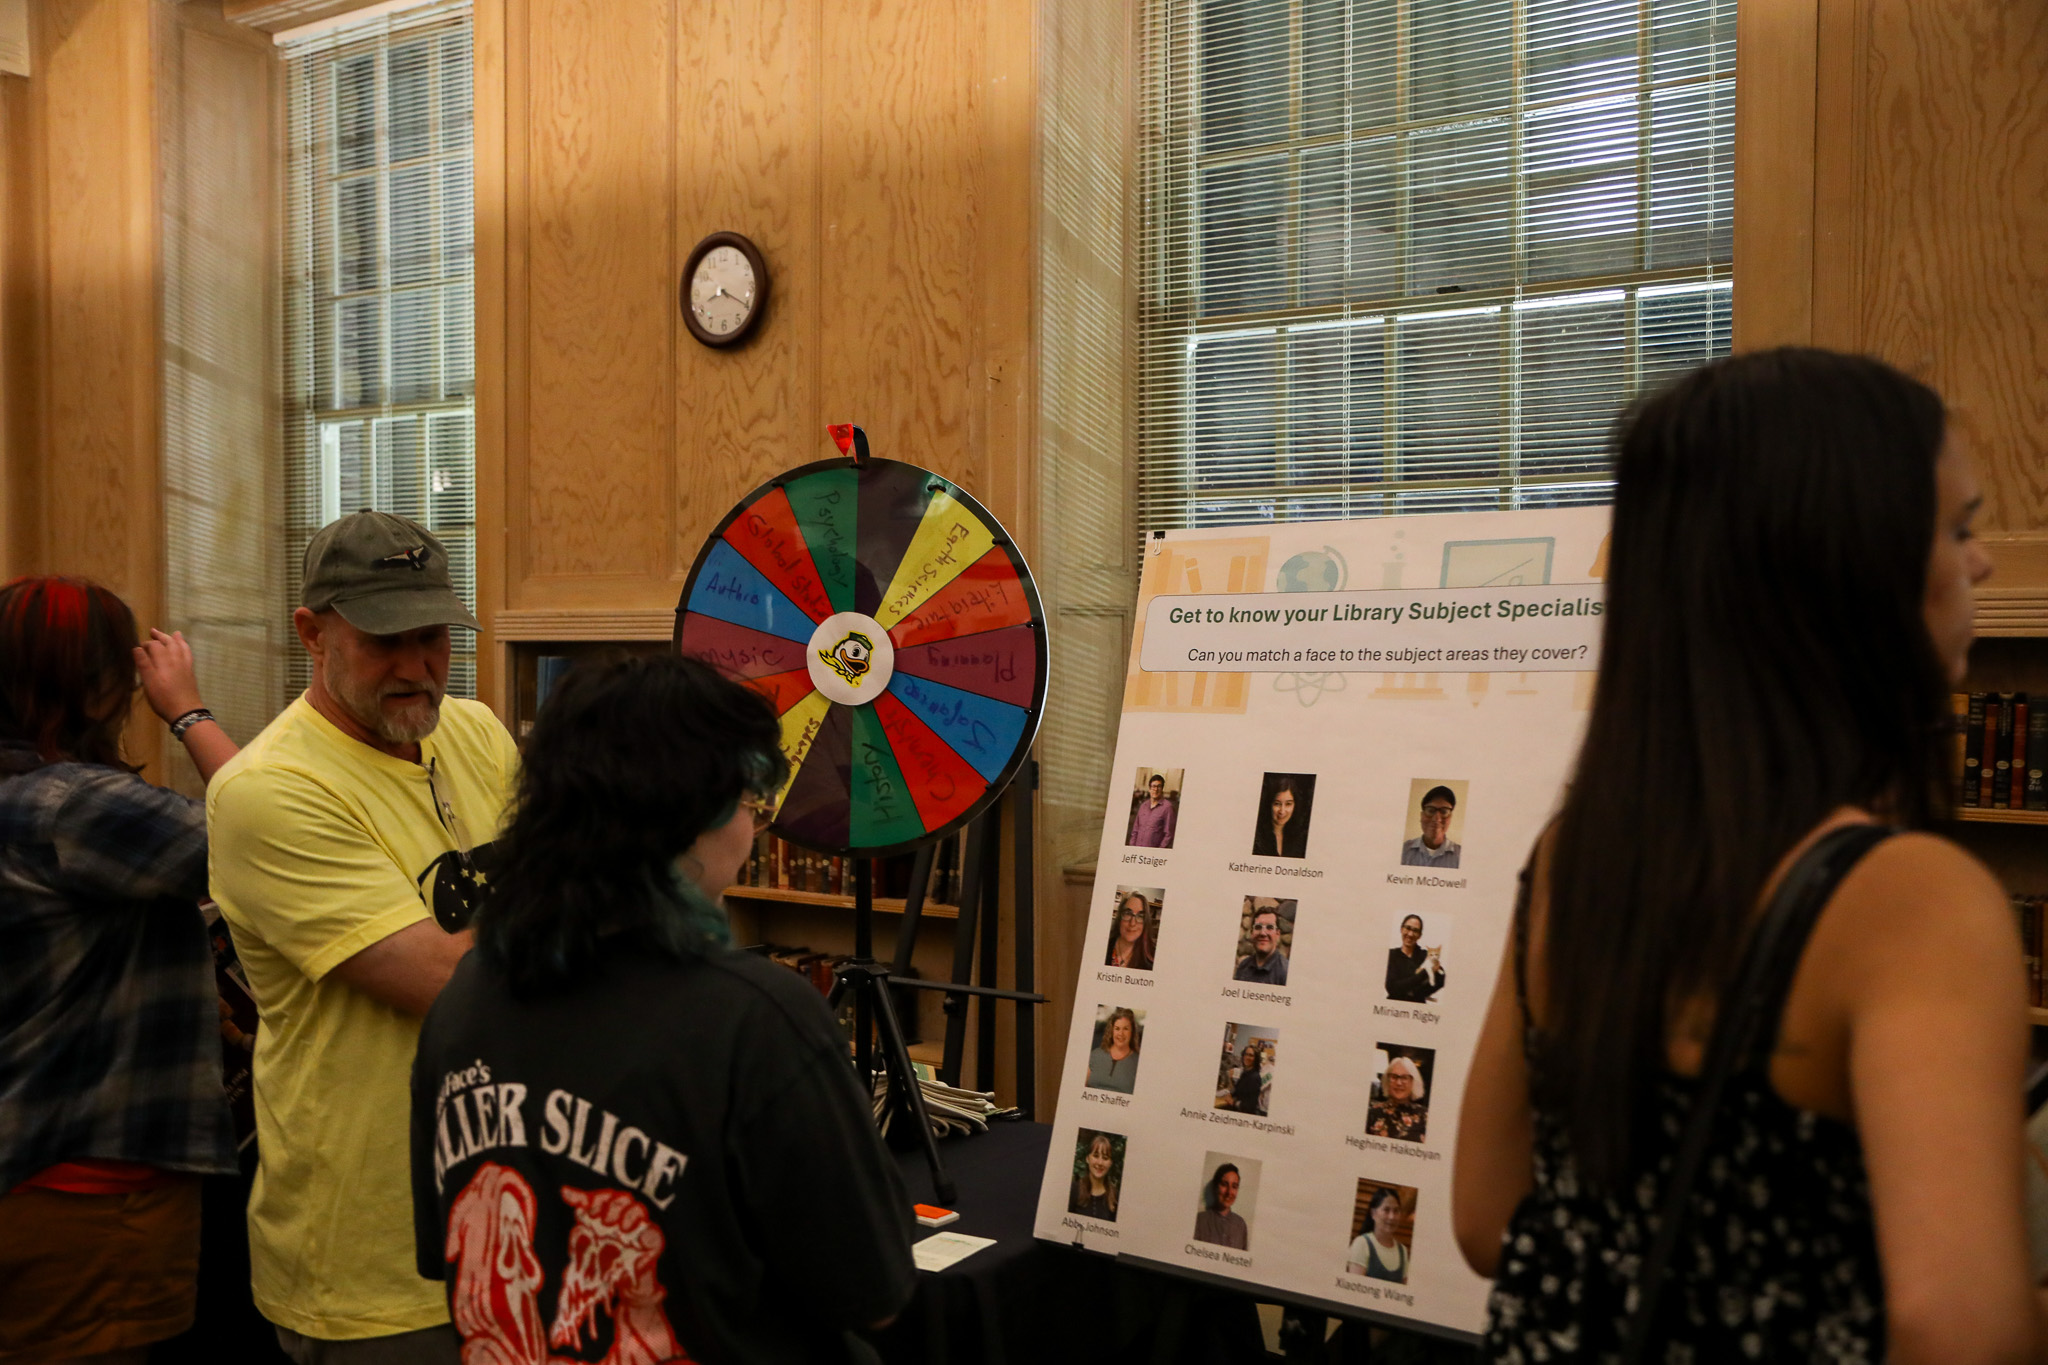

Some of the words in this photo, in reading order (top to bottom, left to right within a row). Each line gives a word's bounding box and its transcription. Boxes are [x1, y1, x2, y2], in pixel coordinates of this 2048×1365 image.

[747, 514, 801, 573] Global
[1169, 608, 1201, 624] Get
[1205, 608, 1224, 624] to
[1228, 606, 1280, 624] know
[1284, 607, 1328, 626] your
[1333, 603, 1403, 625] Library
[1408, 601, 1491, 622] Subject
[1497, 599, 1604, 621] Specialis
[926, 644, 1016, 683] Planning
[1187, 649, 1215, 662] Can
[1218, 651, 1243, 665] you
[1246, 648, 1291, 662] match
[1294, 652, 1302, 661] a
[1305, 648, 1336, 661] face
[1340, 650, 1354, 661] to
[1357, 648, 1382, 661] the
[1385, 647, 1442, 664] subject
[1446, 649, 1489, 661] areas
[1493, 646, 1528, 663] they
[1531, 645, 1588, 660] cover?
[861, 742, 904, 826] History
[1121, 854, 1137, 865] Jeff
[1138, 855, 1168, 868] Staiger
[1228, 862, 1272, 875] Katherine
[1274, 865, 1324, 878] Donaldson
[1386, 874, 1414, 885] Kevin
[1415, 876, 1467, 889] McDowell
[1096, 972, 1122, 984] Kristin
[1124, 975, 1154, 987] Buxton
[1221, 987, 1240, 999] Joel
[1242, 989, 1292, 1006] Liesenberg
[1372, 1005, 1410, 1020] Miriam
[1412, 1009, 1440, 1024] Rigby
[1081, 1091, 1099, 1102] Ann
[1100, 1093, 1131, 1107] Shaffer
[1180, 1107, 1207, 1122] Annie
[1208, 1111, 1295, 1136] Zeidman-Karpinski
[540, 1089, 689, 1211] SLICE
[1345, 1135, 1387, 1153] Heghine
[1389, 1141, 1441, 1161] Hakobyan
[1184, 1244, 1220, 1263] Chelsea
[1221, 1251, 1253, 1268] Nestel
[1335, 1277, 1382, 1299] Xiaotong
[1384, 1286, 1414, 1305] Wang
